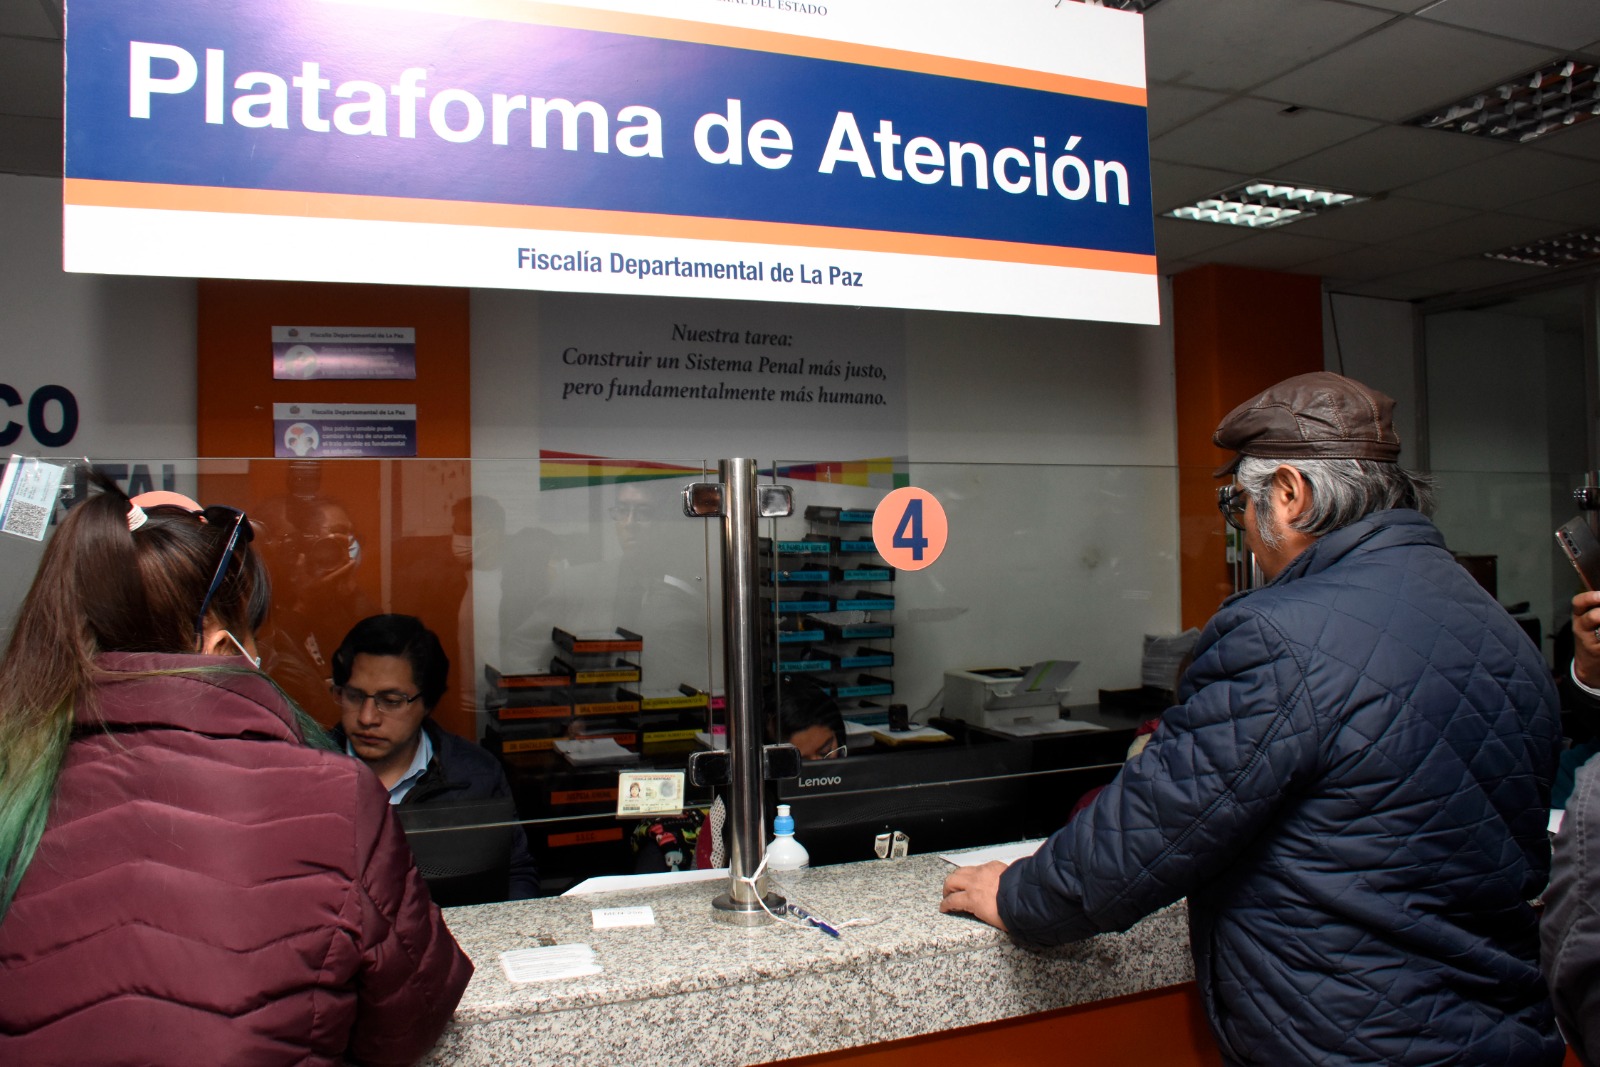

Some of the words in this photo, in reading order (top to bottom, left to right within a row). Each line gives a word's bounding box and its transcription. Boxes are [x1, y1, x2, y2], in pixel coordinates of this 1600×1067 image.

[778, 0, 829, 16] ESTADO
[127, 40, 665, 160] Plataforma
[693, 98, 793, 169] de
[818, 111, 1131, 207] Atención
[517, 247, 602, 273] Fiscalía
[610, 252, 764, 281] Departamental
[770, 262, 794, 283] de
[800, 264, 823, 284] La
[829, 266, 864, 287] Paz
[672, 324, 740, 344] Nuestra
[744, 330, 793, 347] tarea:
[562, 347, 652, 368] Construir
[656, 356, 680, 369] un
[685, 353, 753, 372] Sistema
[758, 356, 804, 375] Penal
[808, 360, 841, 377] más
[842, 361, 887, 382] justo,
[562, 382, 604, 401] pero
[603, 377, 776, 404] fundamentalmente
[780, 384, 813, 403] más
[818, 385, 887, 406] humano.
[892, 498, 928, 561] 4
[798, 773, 842, 787] Lenovo
